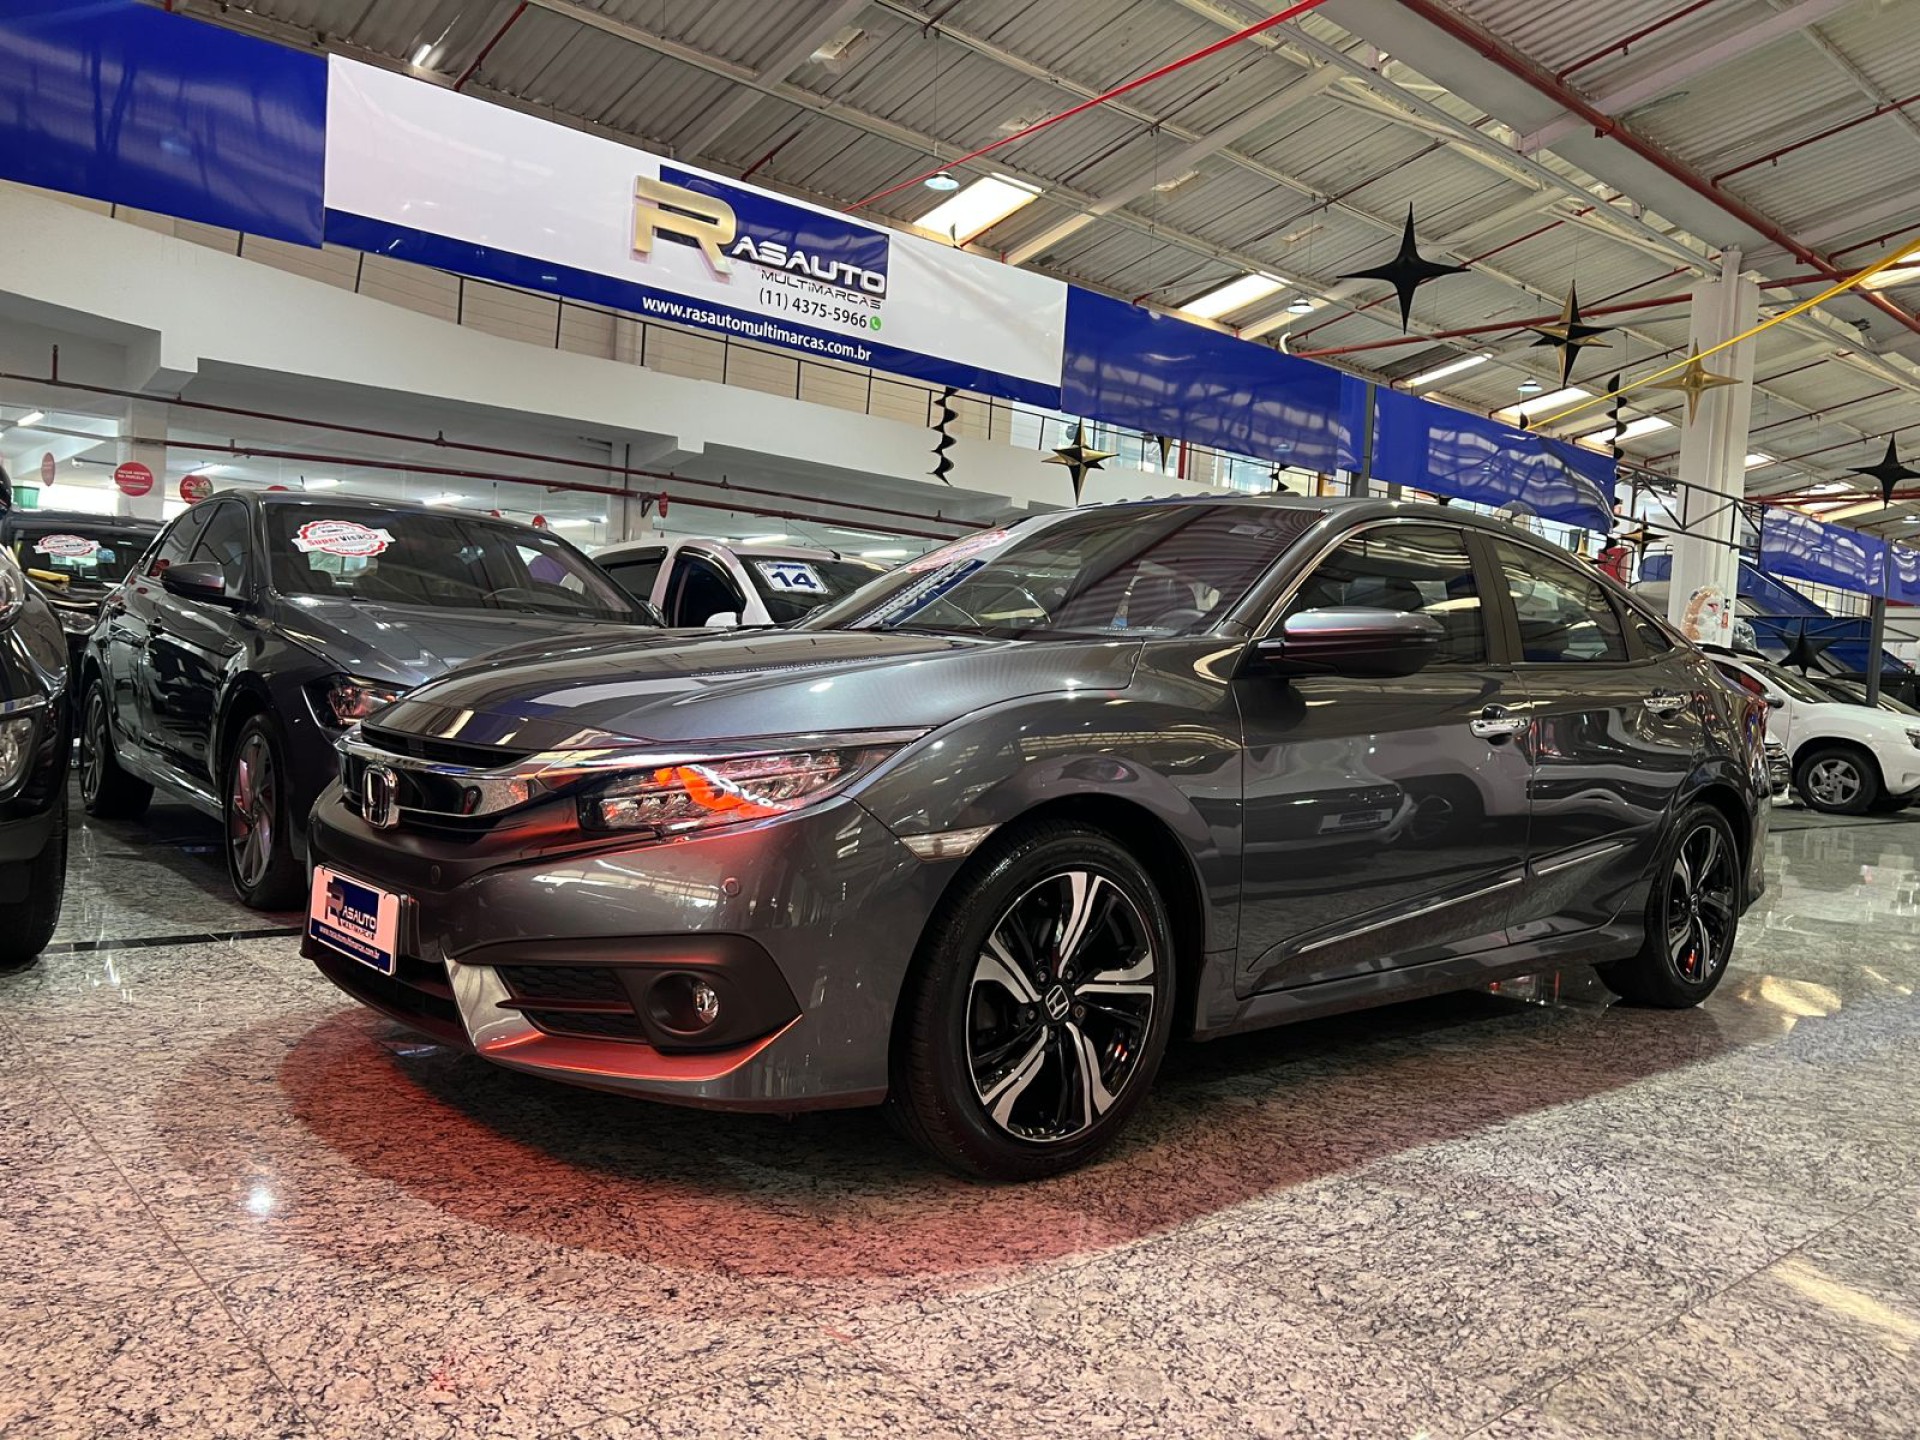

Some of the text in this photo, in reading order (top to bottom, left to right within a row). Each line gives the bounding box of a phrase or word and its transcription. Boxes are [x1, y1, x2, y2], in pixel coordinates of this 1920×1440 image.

[632, 175, 886, 294] RASAUTO
[642, 296, 872, 362] www.rasautomultimarcas.com.br
[759, 287, 868, 329] (11) 4375-5966
[771, 571, 818, 590] 14
